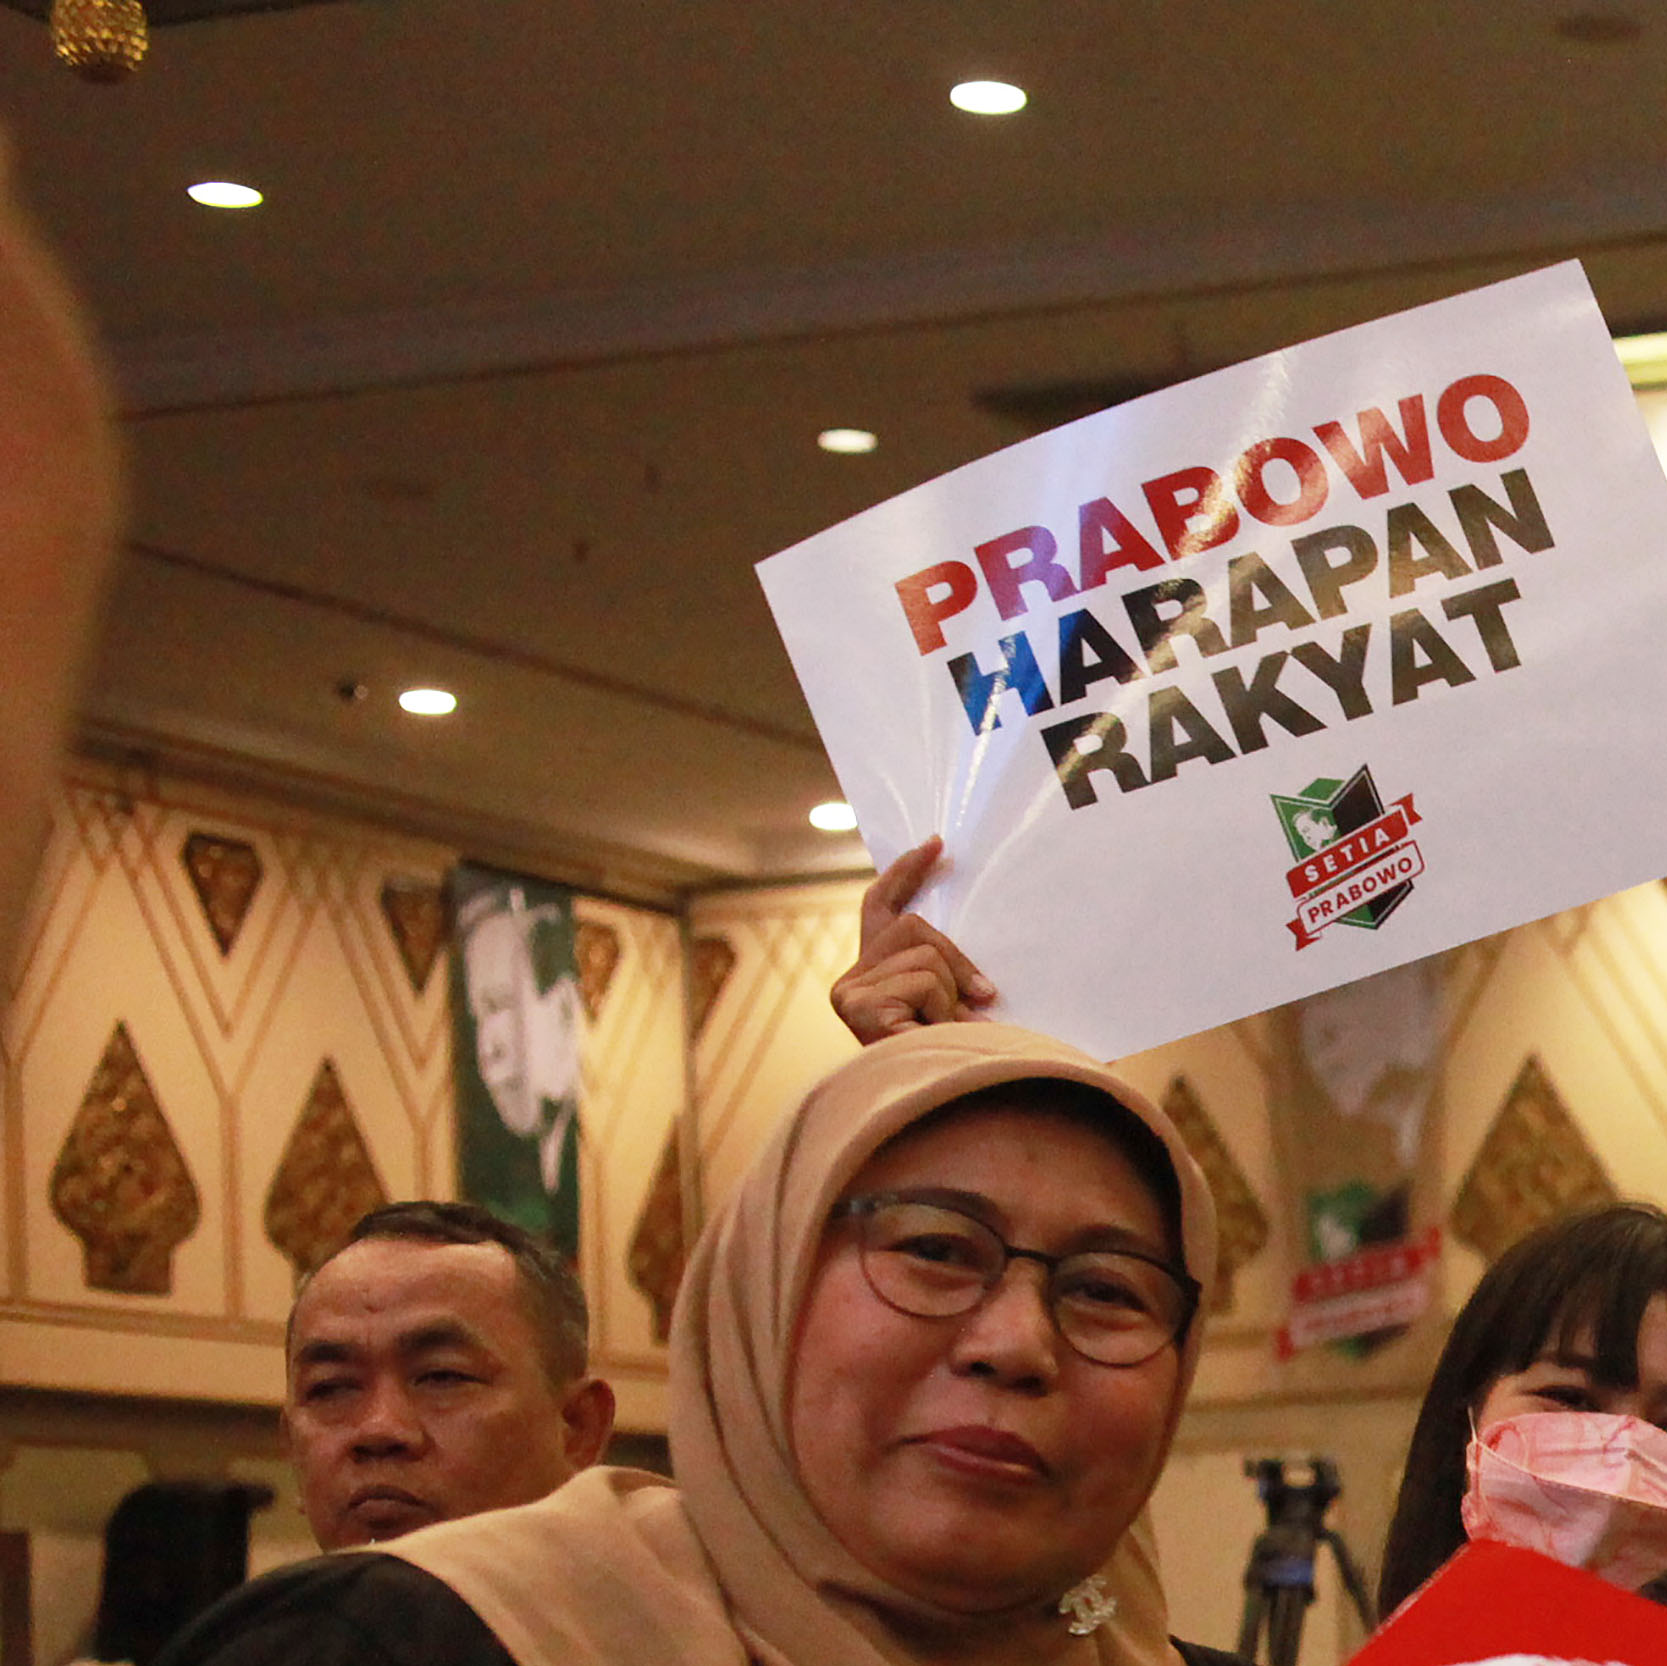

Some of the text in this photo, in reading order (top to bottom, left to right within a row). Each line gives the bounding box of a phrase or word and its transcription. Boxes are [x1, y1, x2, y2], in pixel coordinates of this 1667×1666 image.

[894, 373, 1531, 657] PRABOWO
[946, 468, 1557, 736] HARAPAN
[1041, 578, 1523, 811] RAKYAT
[1302, 825, 1392, 883] SETIA
[1306, 853, 1416, 927] PRABOWO
